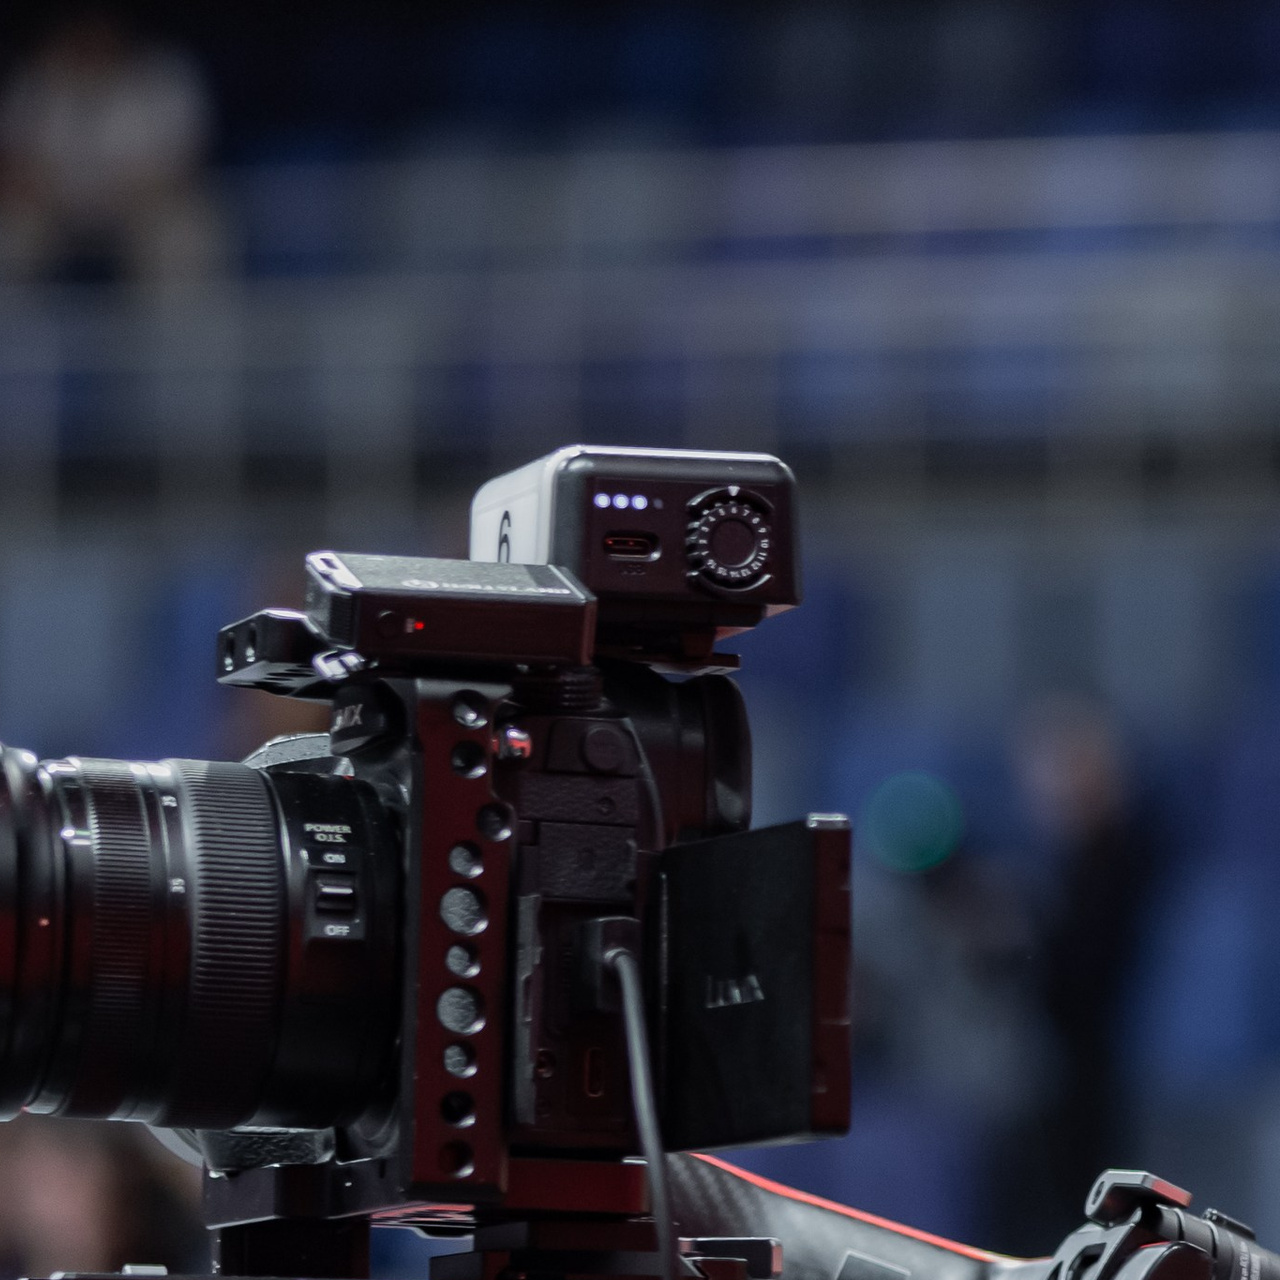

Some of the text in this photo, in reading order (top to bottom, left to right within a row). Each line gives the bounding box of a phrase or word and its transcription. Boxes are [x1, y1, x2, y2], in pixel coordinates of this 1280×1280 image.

[303, 823, 352, 834] POWER
[323, 853, 347, 864] ON
[324, 924, 350, 936] OFF
